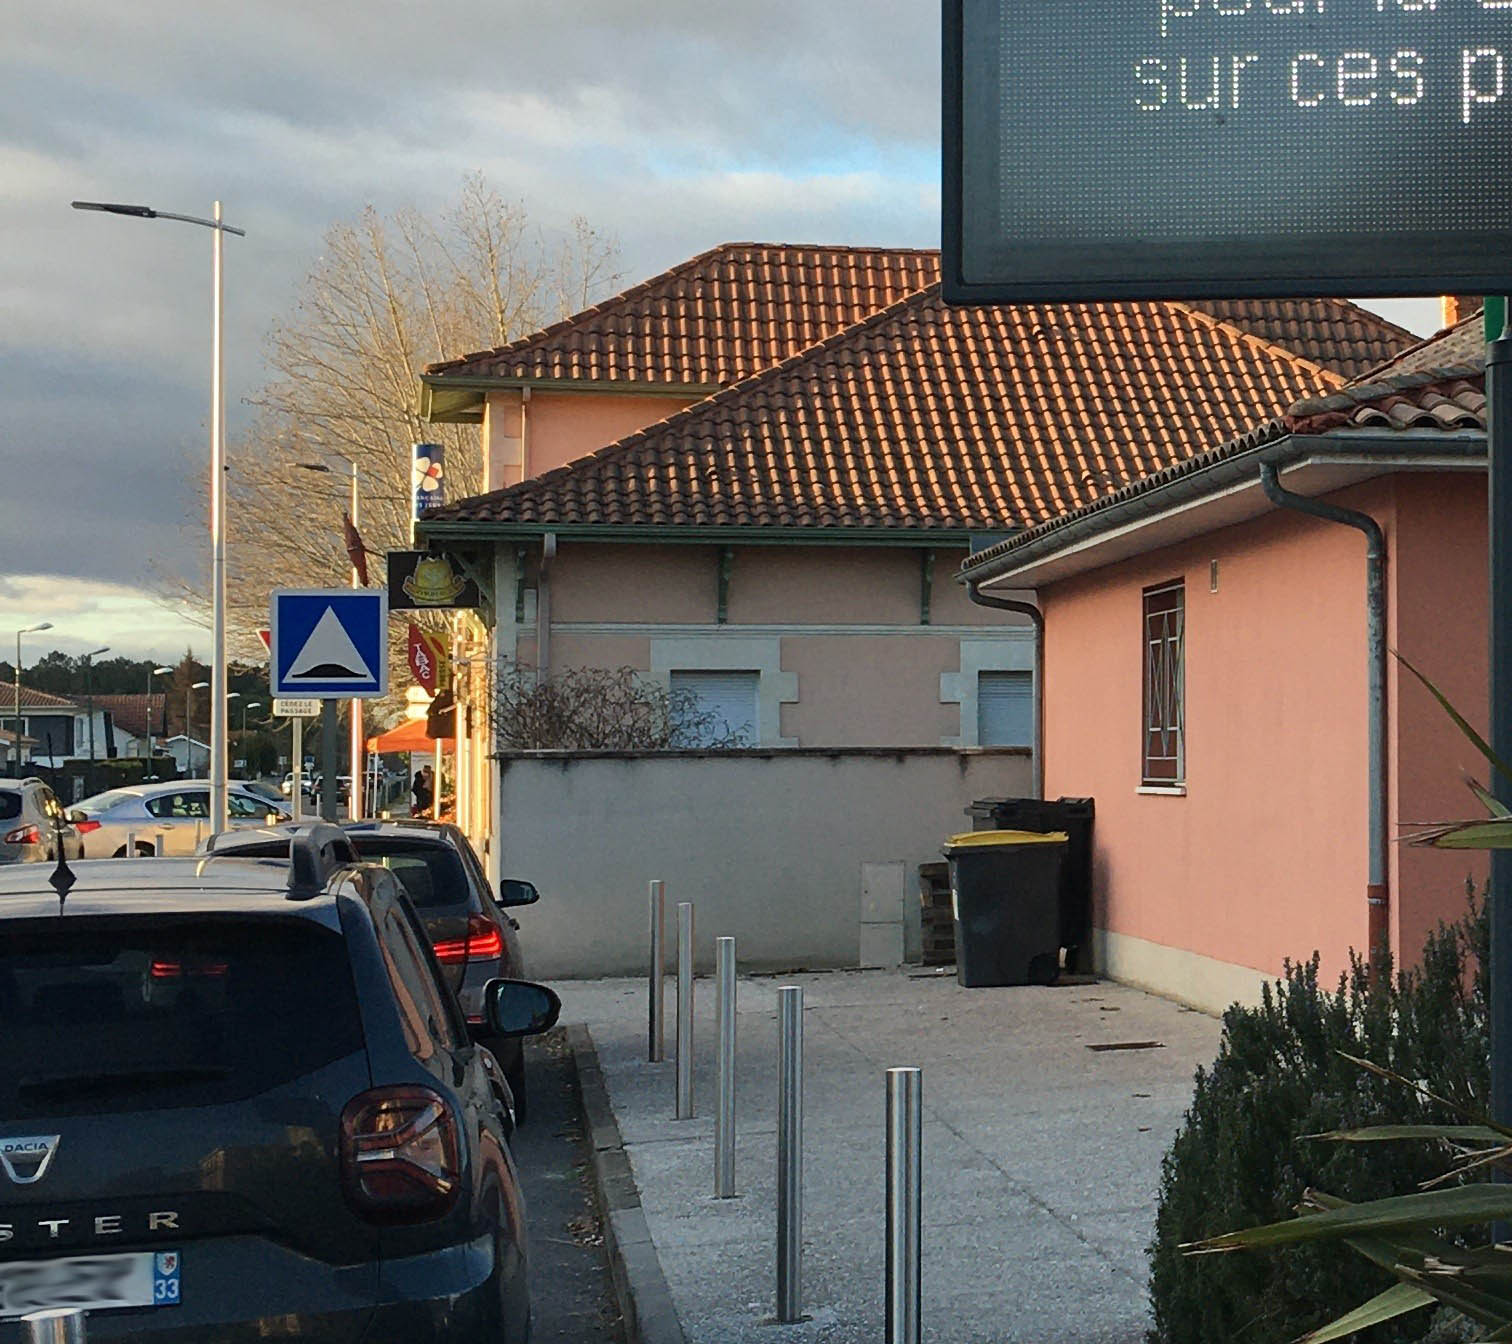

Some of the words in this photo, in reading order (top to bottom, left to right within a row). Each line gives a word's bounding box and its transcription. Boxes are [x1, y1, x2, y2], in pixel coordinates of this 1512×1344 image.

[1135, 55, 1259, 111] sur
[1291, 50, 1424, 108] ces
[4, 1142, 48, 1153] DACIA
[155, 1278, 179, 1299] 33
